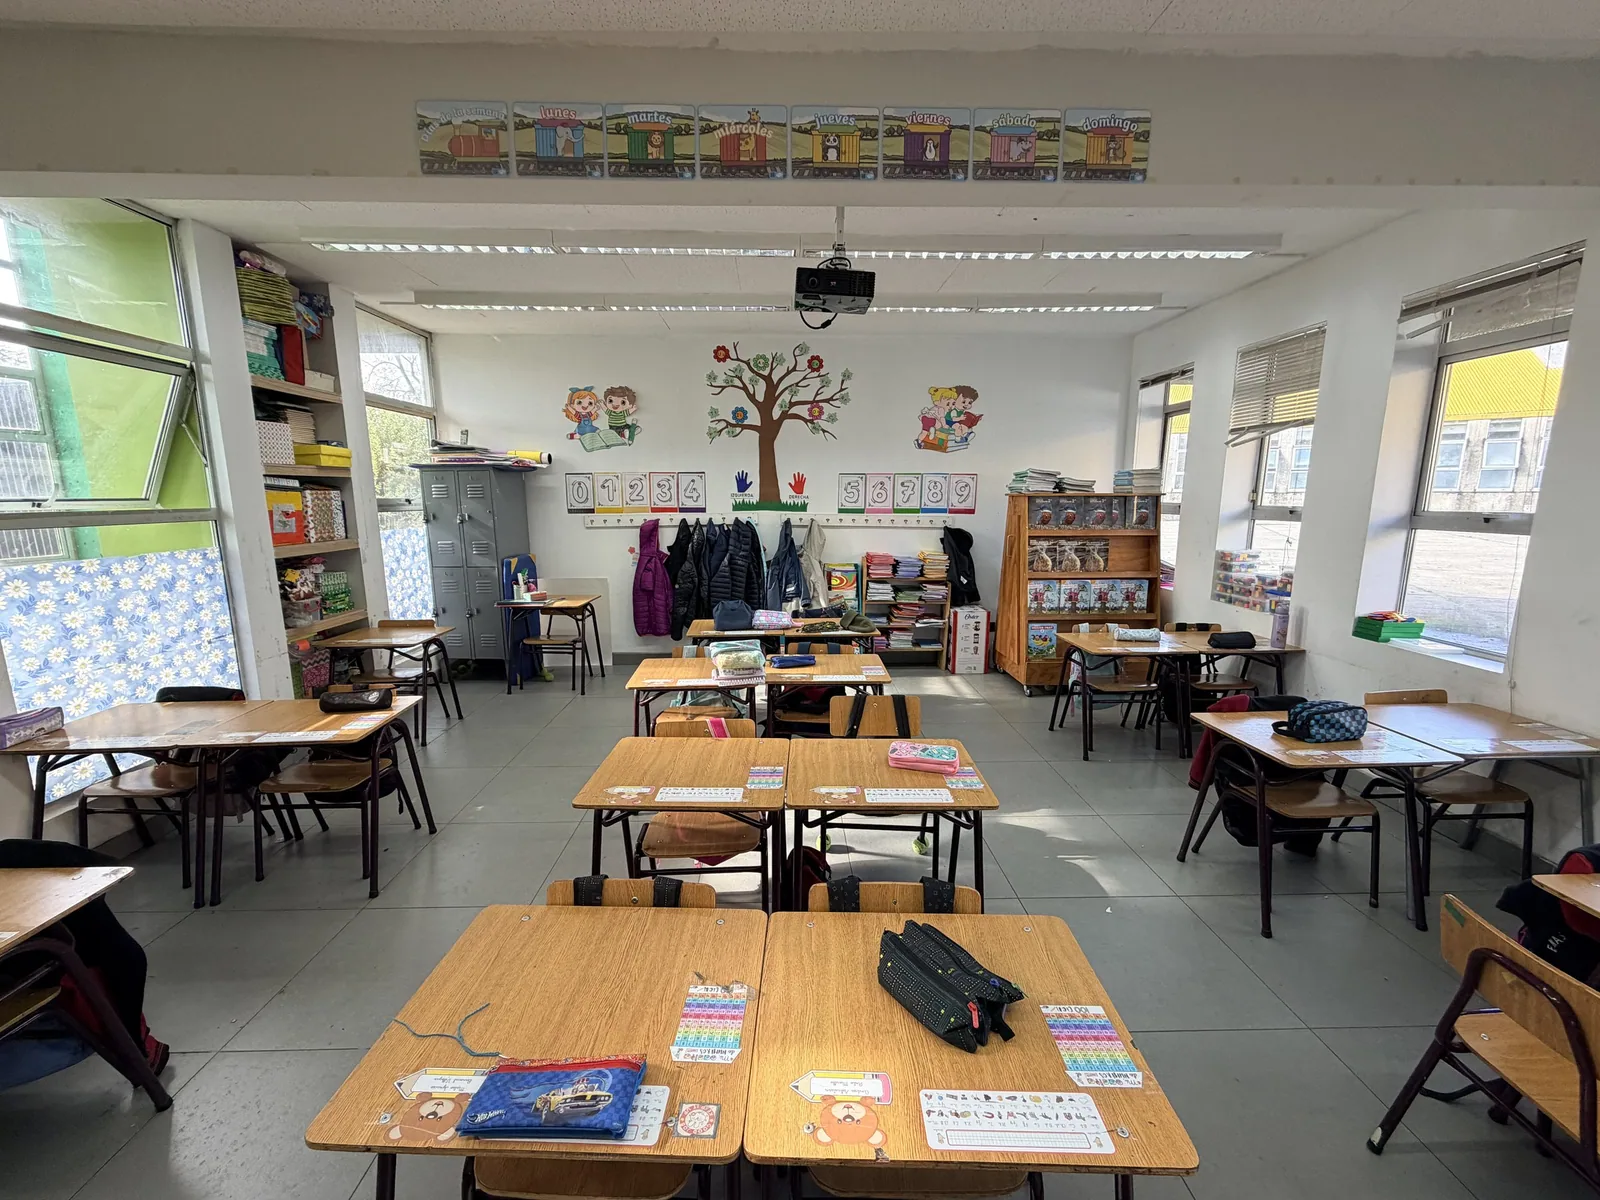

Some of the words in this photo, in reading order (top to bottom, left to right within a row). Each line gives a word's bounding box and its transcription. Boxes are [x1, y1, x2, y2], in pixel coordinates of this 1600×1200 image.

[440, 111, 452, 122] de
[453, 107, 463, 117] la
[464, 107, 506, 120] semana
[538, 105, 577, 120] lunes
[627, 110, 672, 124] martes
[813, 113, 856, 128] jueves
[904, 111, 951, 126] viernes
[991, 113, 1037, 128] sábado
[1082, 115, 1139, 133] domingo
[713, 121, 774, 139] miércoles
[572, 480, 589, 503] 0
[600, 478, 615, 502] 1
[628, 478, 644, 501] 2
[656, 479, 672, 502] 3
[684, 478, 700, 502] 4
[844, 480, 860, 503] 5
[872, 480, 888, 503] 6
[901, 480, 915, 503] 7
[927, 480, 943, 503] 8
[955, 480, 971, 503] 9
